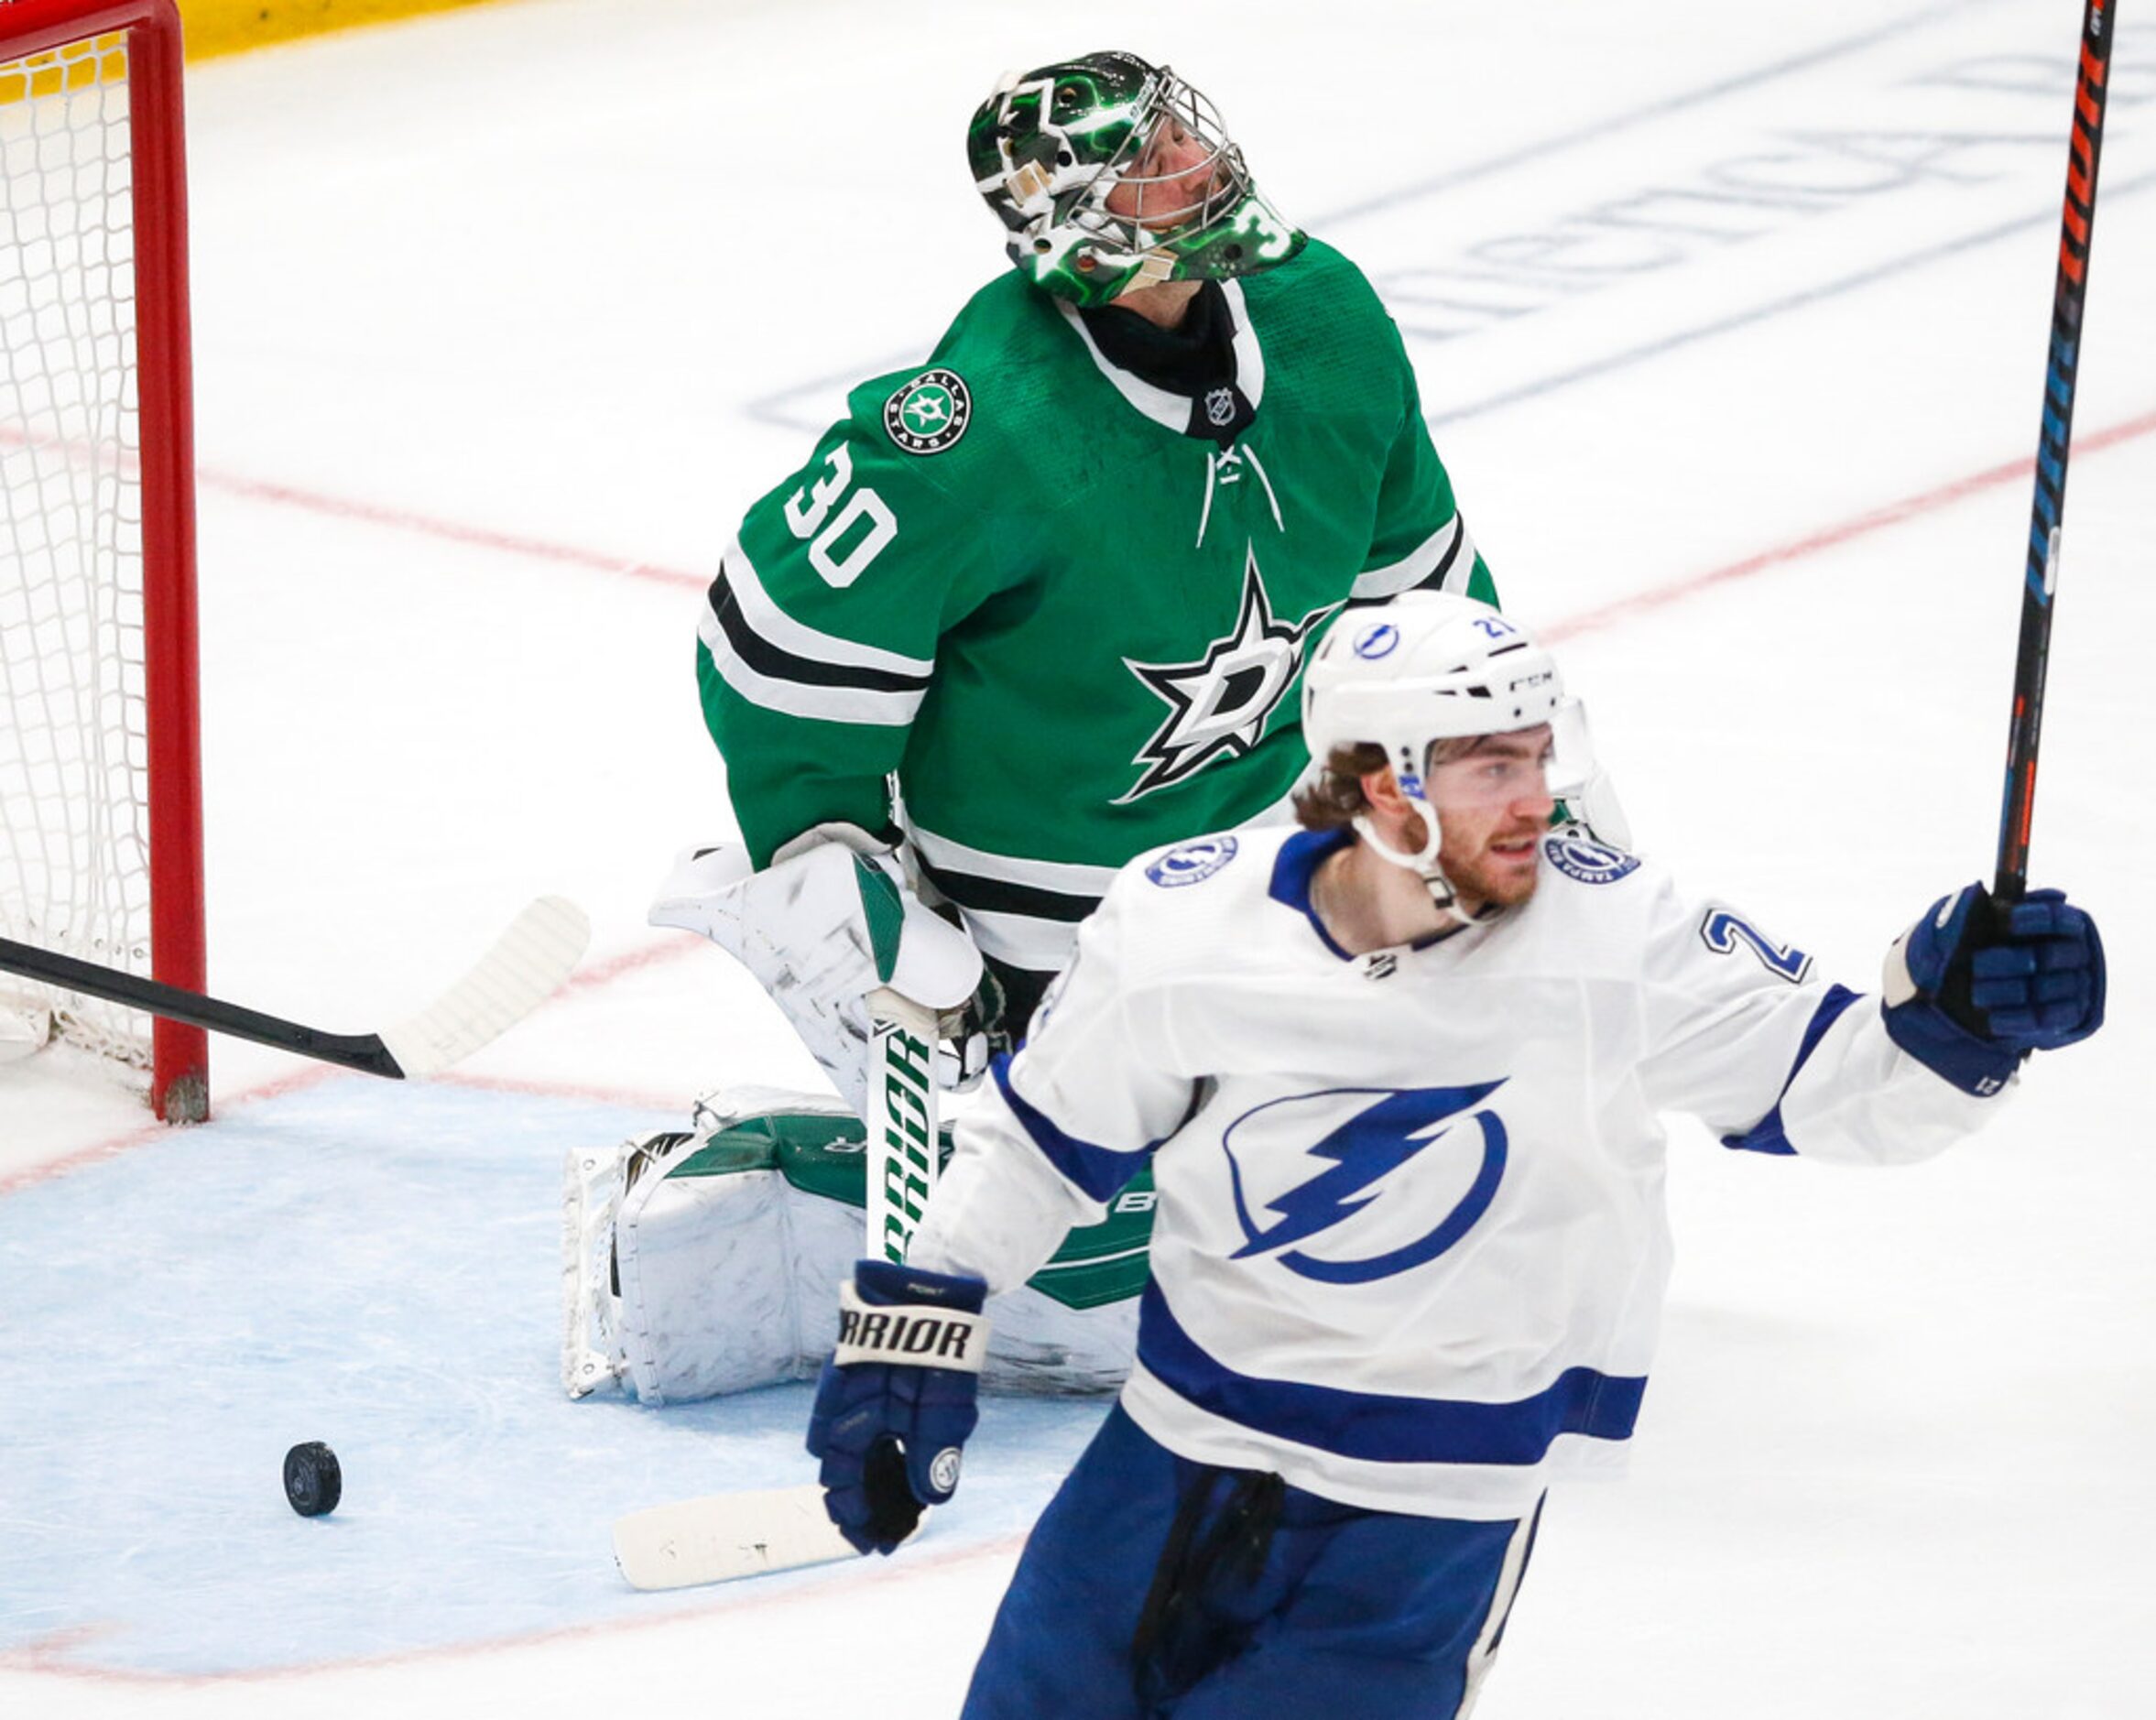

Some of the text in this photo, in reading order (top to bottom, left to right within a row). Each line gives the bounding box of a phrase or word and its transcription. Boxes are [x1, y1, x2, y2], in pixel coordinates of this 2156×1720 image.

[889, 403, 941, 449] STARS
[910, 373, 965, 427] DALLAS
[783, 440, 898, 589] 30
[884, 1029, 930, 1266] RRIOR
[839, 1309, 973, 1359] RRIOR
